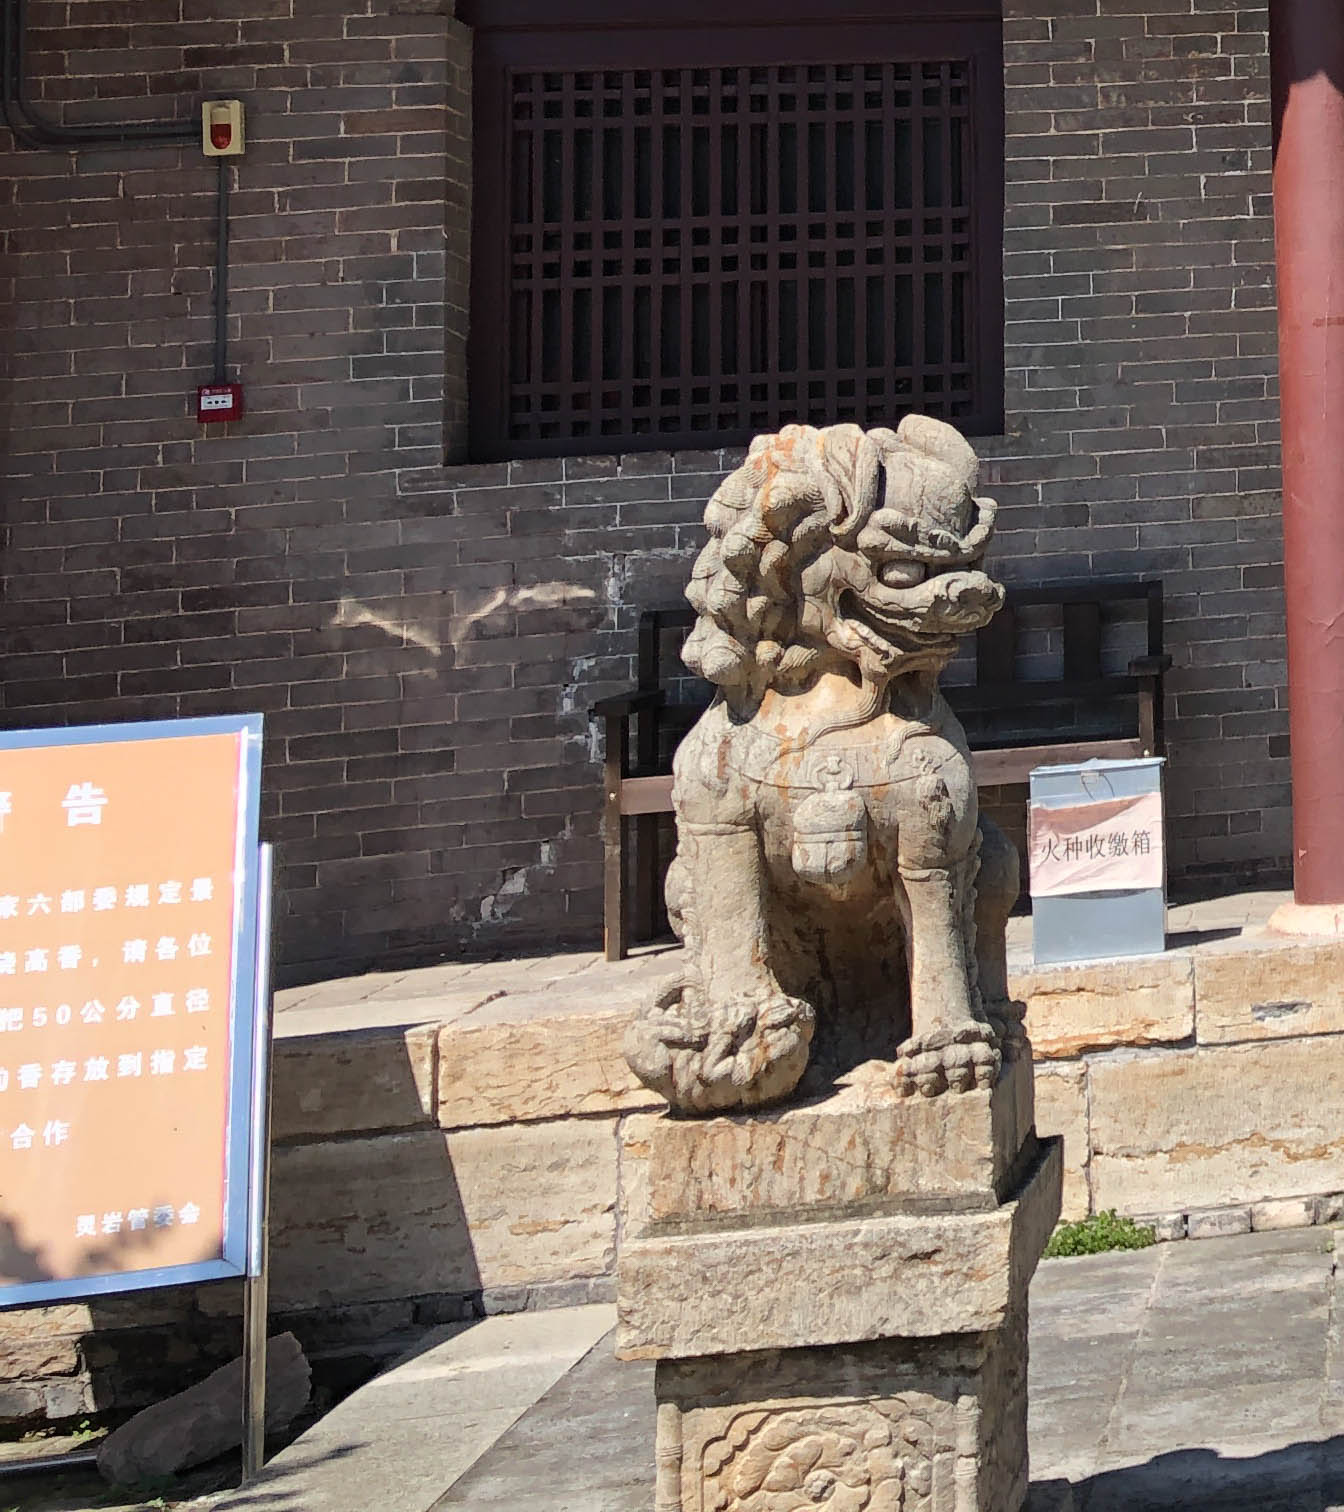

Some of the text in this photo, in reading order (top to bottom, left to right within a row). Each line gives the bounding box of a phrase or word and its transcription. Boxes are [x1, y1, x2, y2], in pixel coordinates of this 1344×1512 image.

[1040, 830, 1150, 863] 火种收缴箱
[10, 1120, 70, 1151] 合作
[76, 1202, 200, 1238] 灵岩管委会
